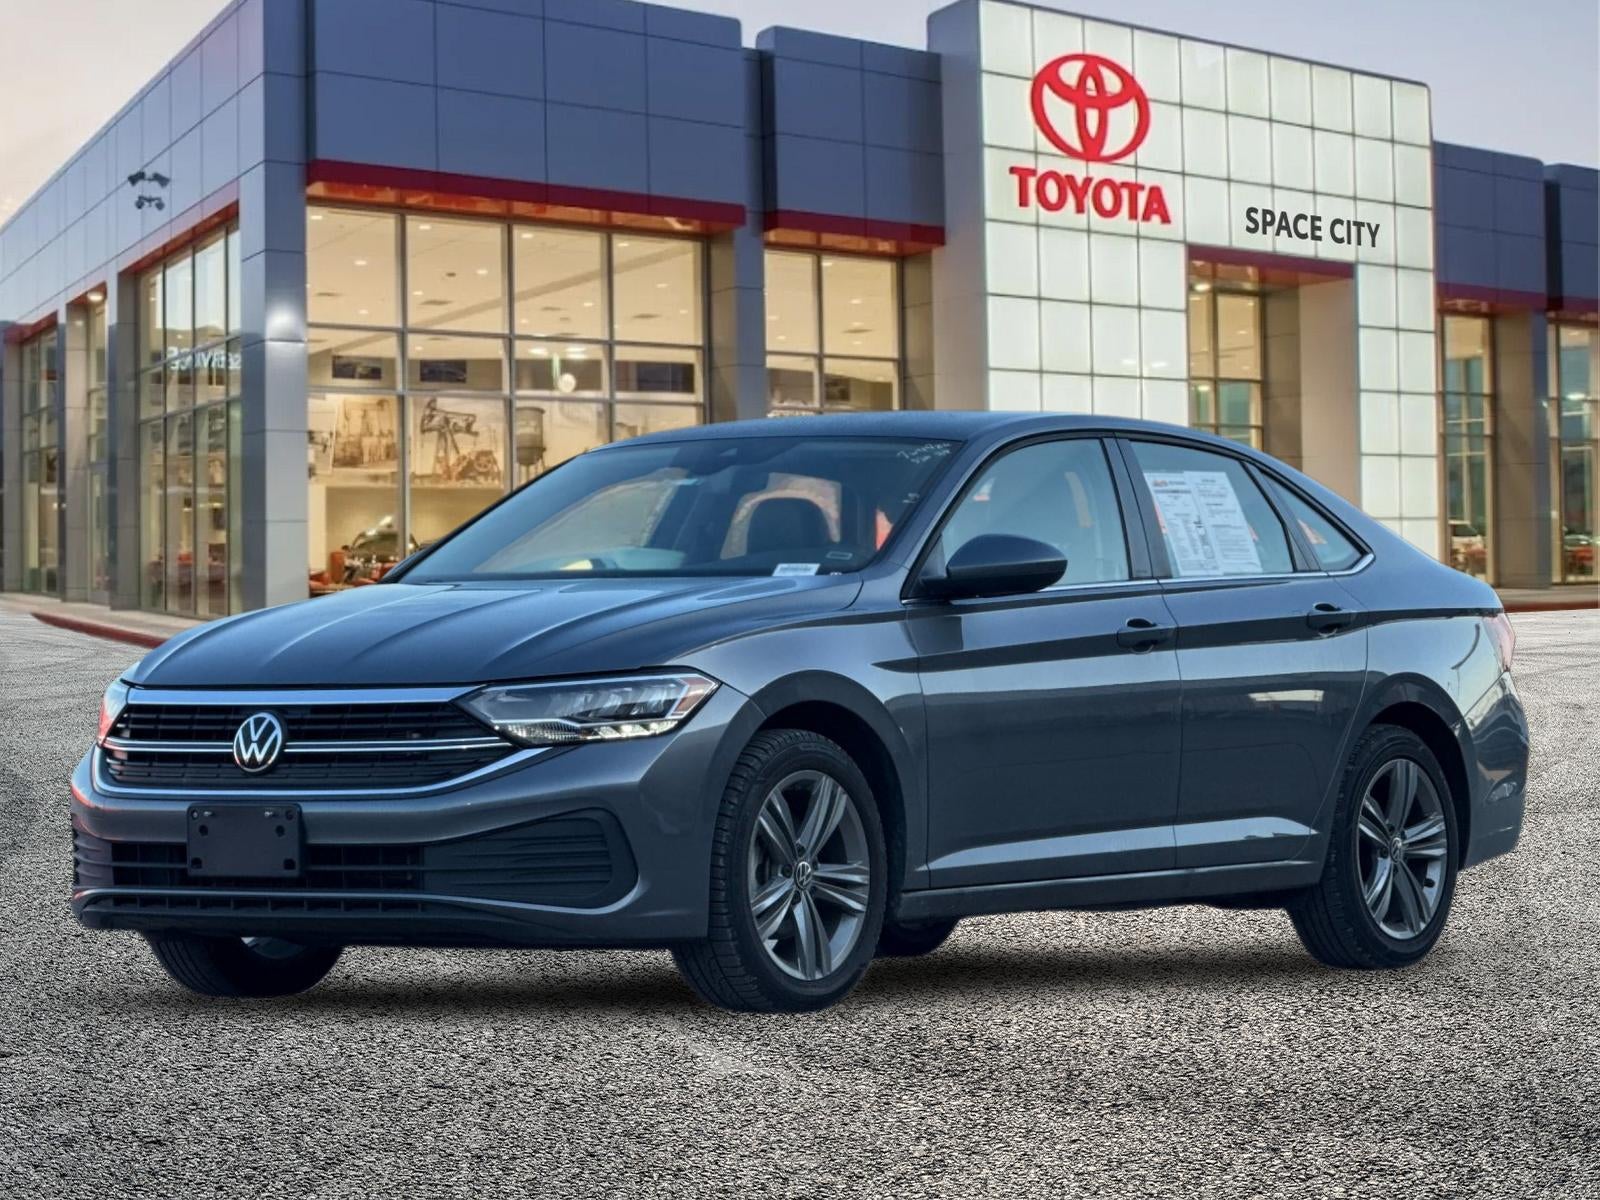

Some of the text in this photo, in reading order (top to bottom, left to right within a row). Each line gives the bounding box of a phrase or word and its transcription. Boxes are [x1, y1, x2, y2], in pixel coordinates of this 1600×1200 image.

[1009, 165, 1171, 225] TOYOTA
[1245, 206, 1381, 248] SPACE CITY
[236, 714, 280, 768] VW
